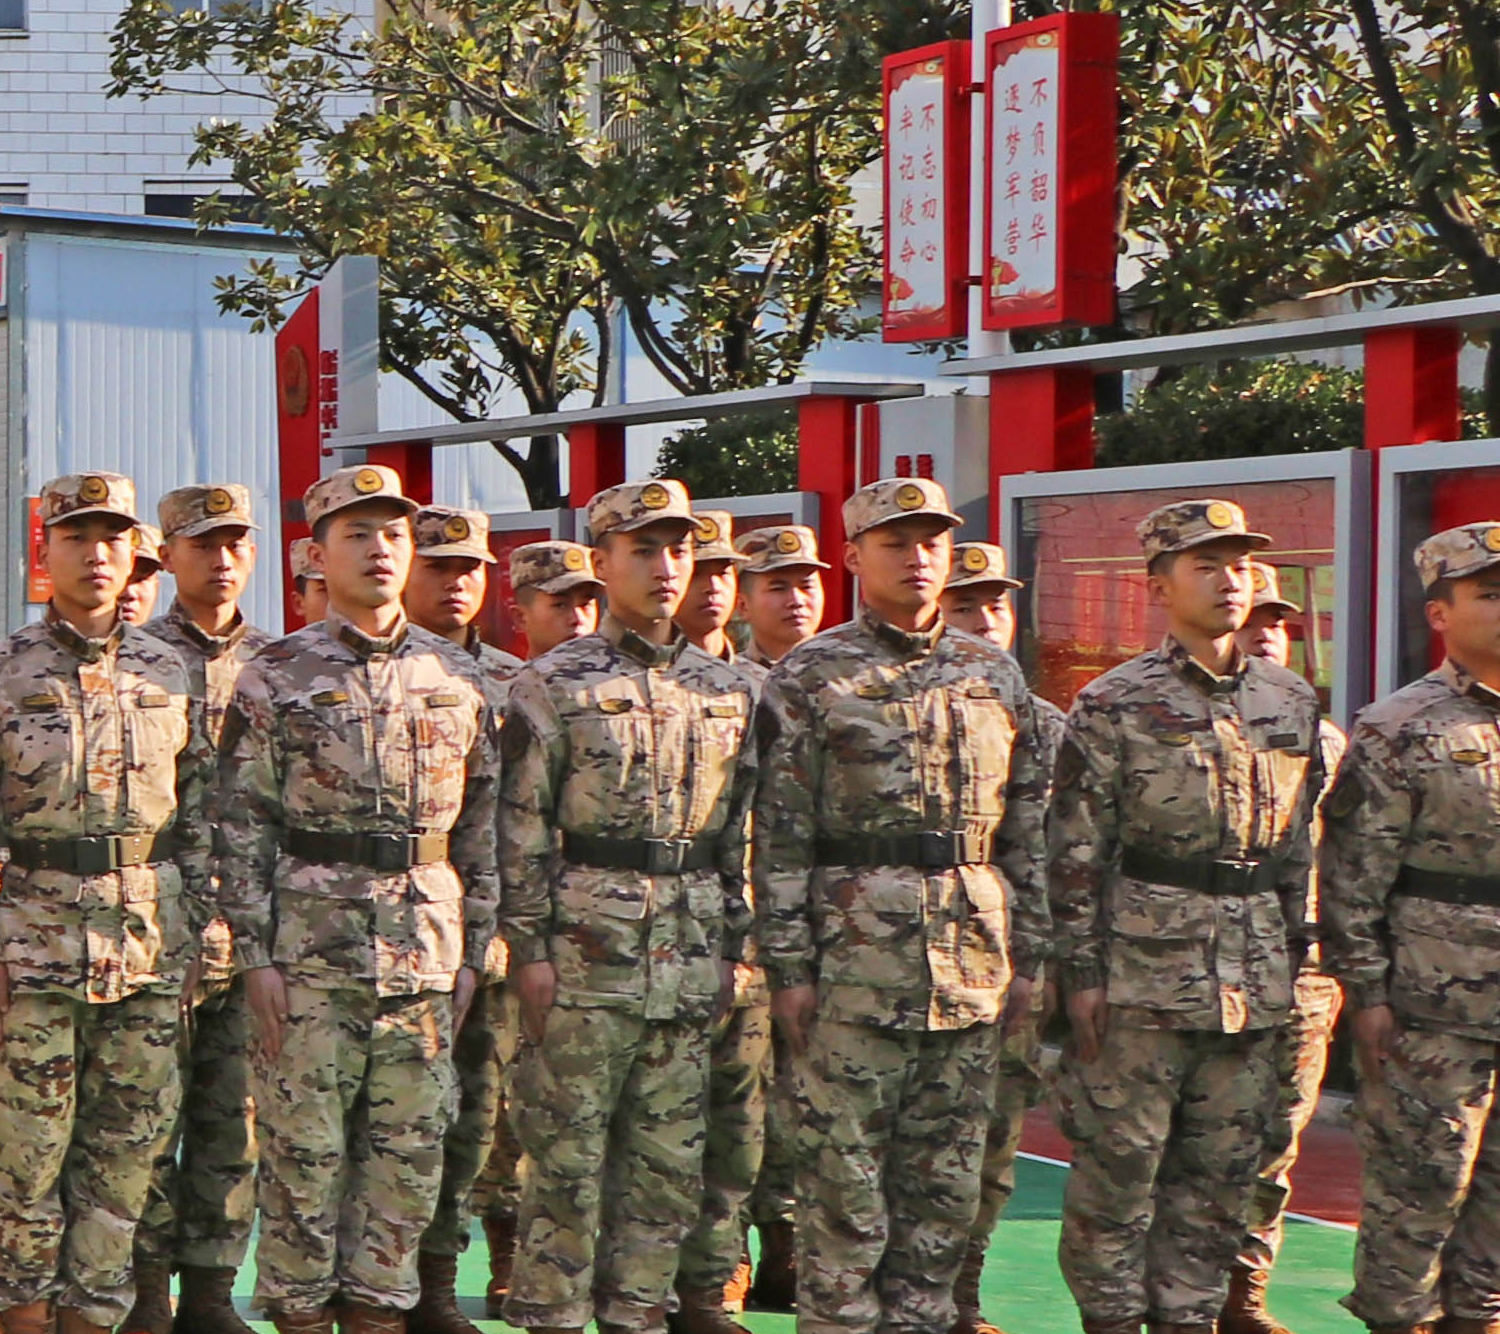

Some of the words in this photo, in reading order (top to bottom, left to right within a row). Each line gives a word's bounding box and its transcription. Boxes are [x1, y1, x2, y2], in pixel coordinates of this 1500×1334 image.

[899, 105, 916, 266] 牢记使命
[920, 103, 937, 262] 不忘初心
[1029, 78, 1048, 252] 不负韶华
